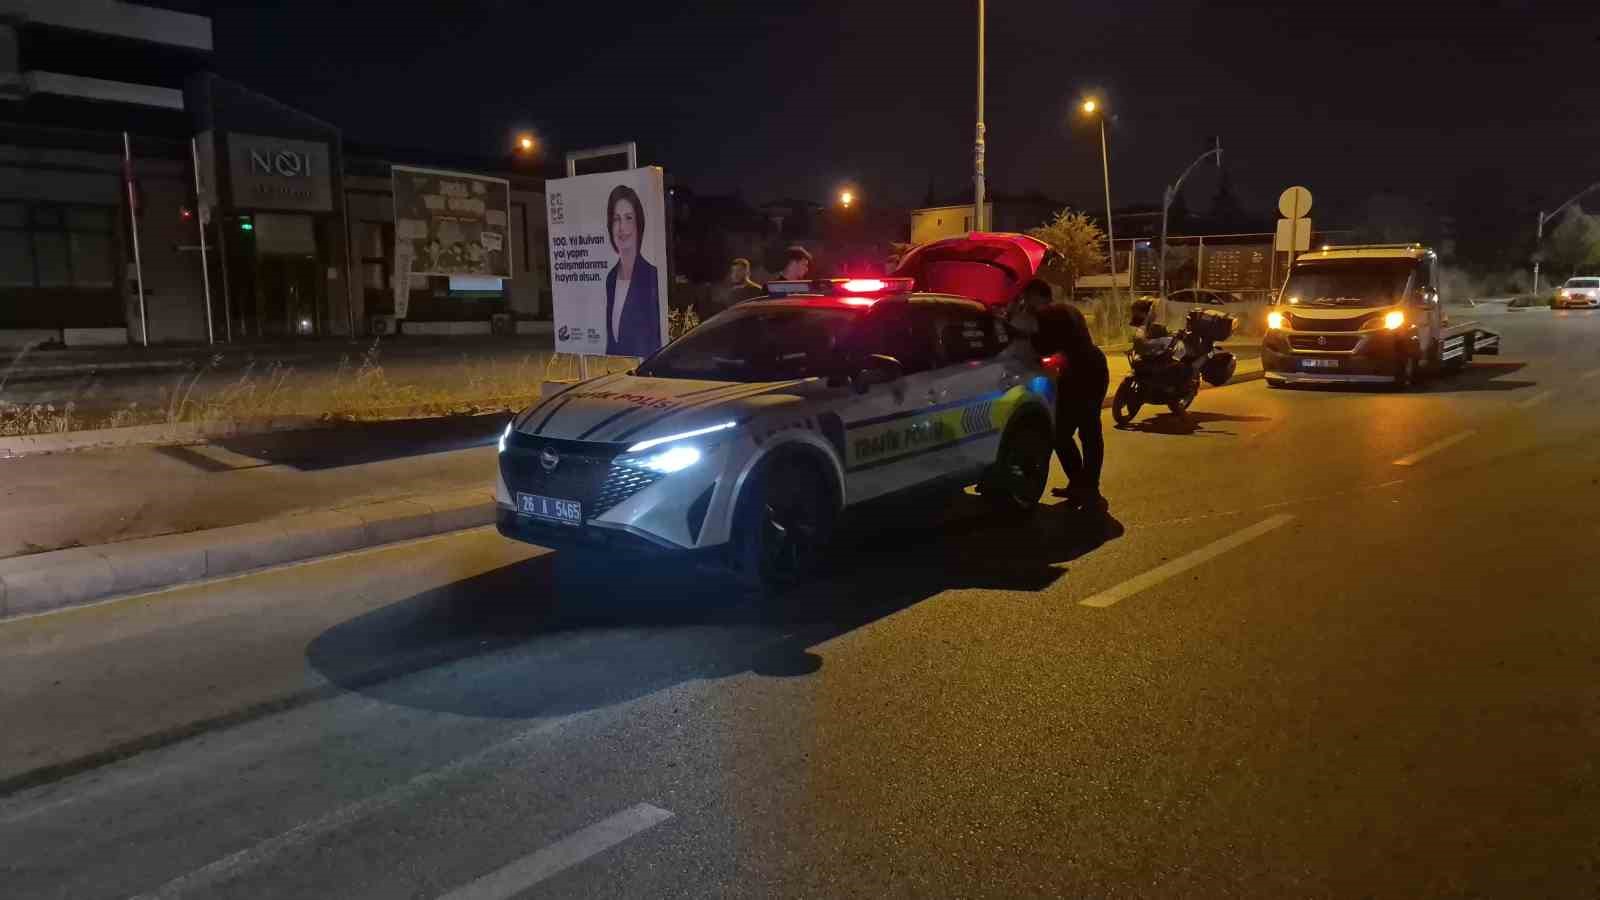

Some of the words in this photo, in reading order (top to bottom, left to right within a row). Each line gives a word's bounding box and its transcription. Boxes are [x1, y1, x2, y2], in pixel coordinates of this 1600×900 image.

[553, 250, 565, 260] yol
[522, 496, 534, 511] 26
[542, 499, 548, 513] A
[556, 501, 580, 521] 5465
